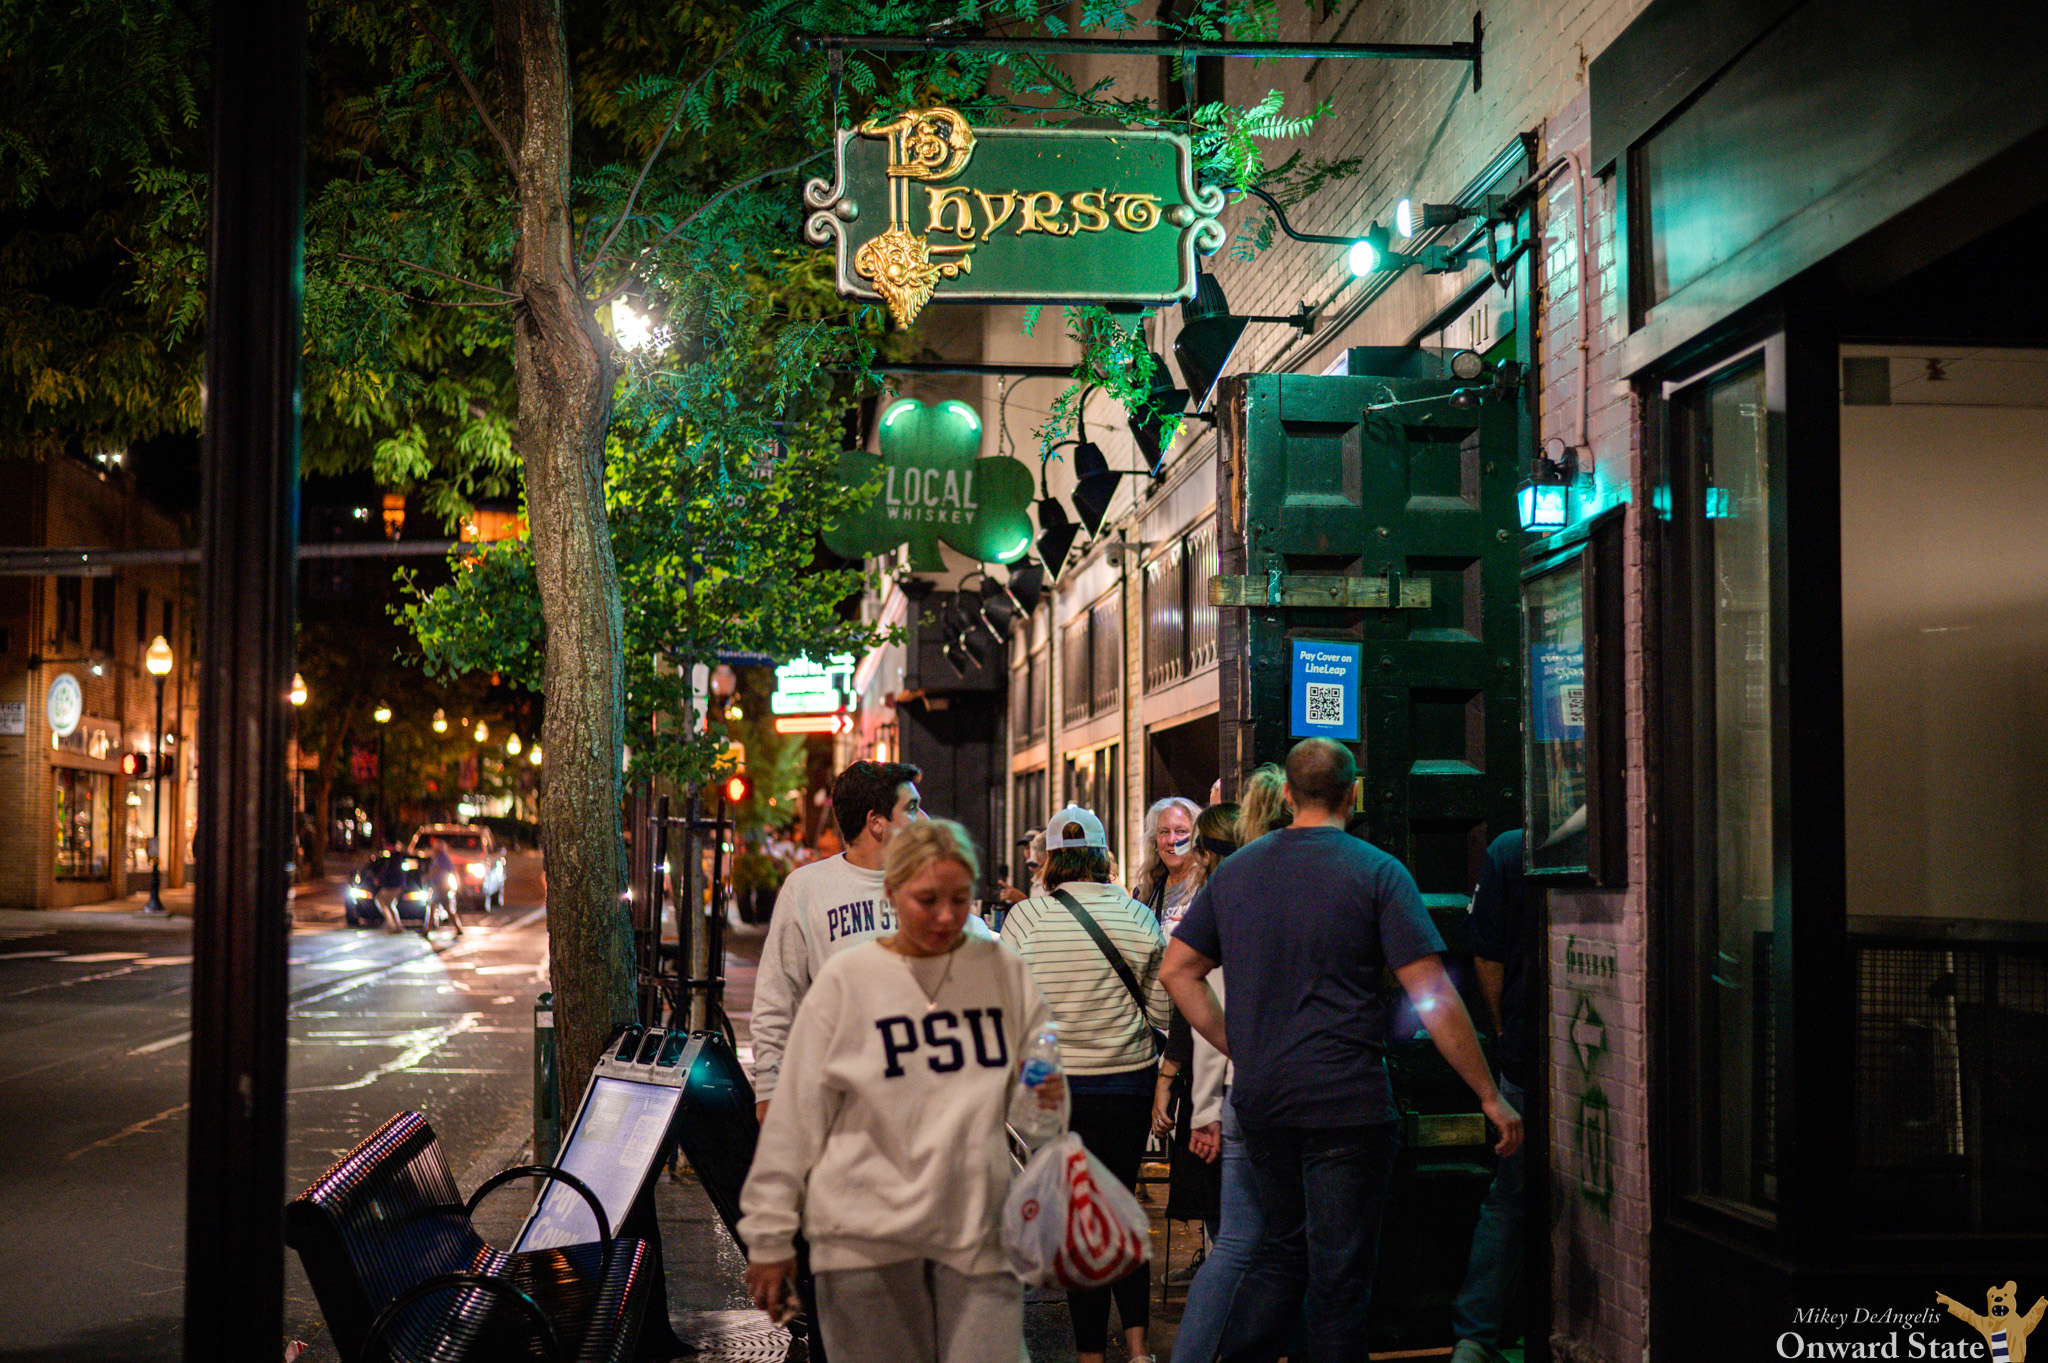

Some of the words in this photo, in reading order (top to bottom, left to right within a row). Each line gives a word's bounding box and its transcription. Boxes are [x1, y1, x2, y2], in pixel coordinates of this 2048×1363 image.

[886, 466, 978, 509] LOCAL
[887, 507, 976, 524] WHISKEY
[1300, 651, 1316, 662] Pay
[1317, 652, 1340, 662] Cover
[1305, 663, 1346, 676] LineLeap
[827, 900, 875, 942] PENN
[875, 1007, 1009, 1078] PSU
[545, 1182, 582, 1222] Pay
